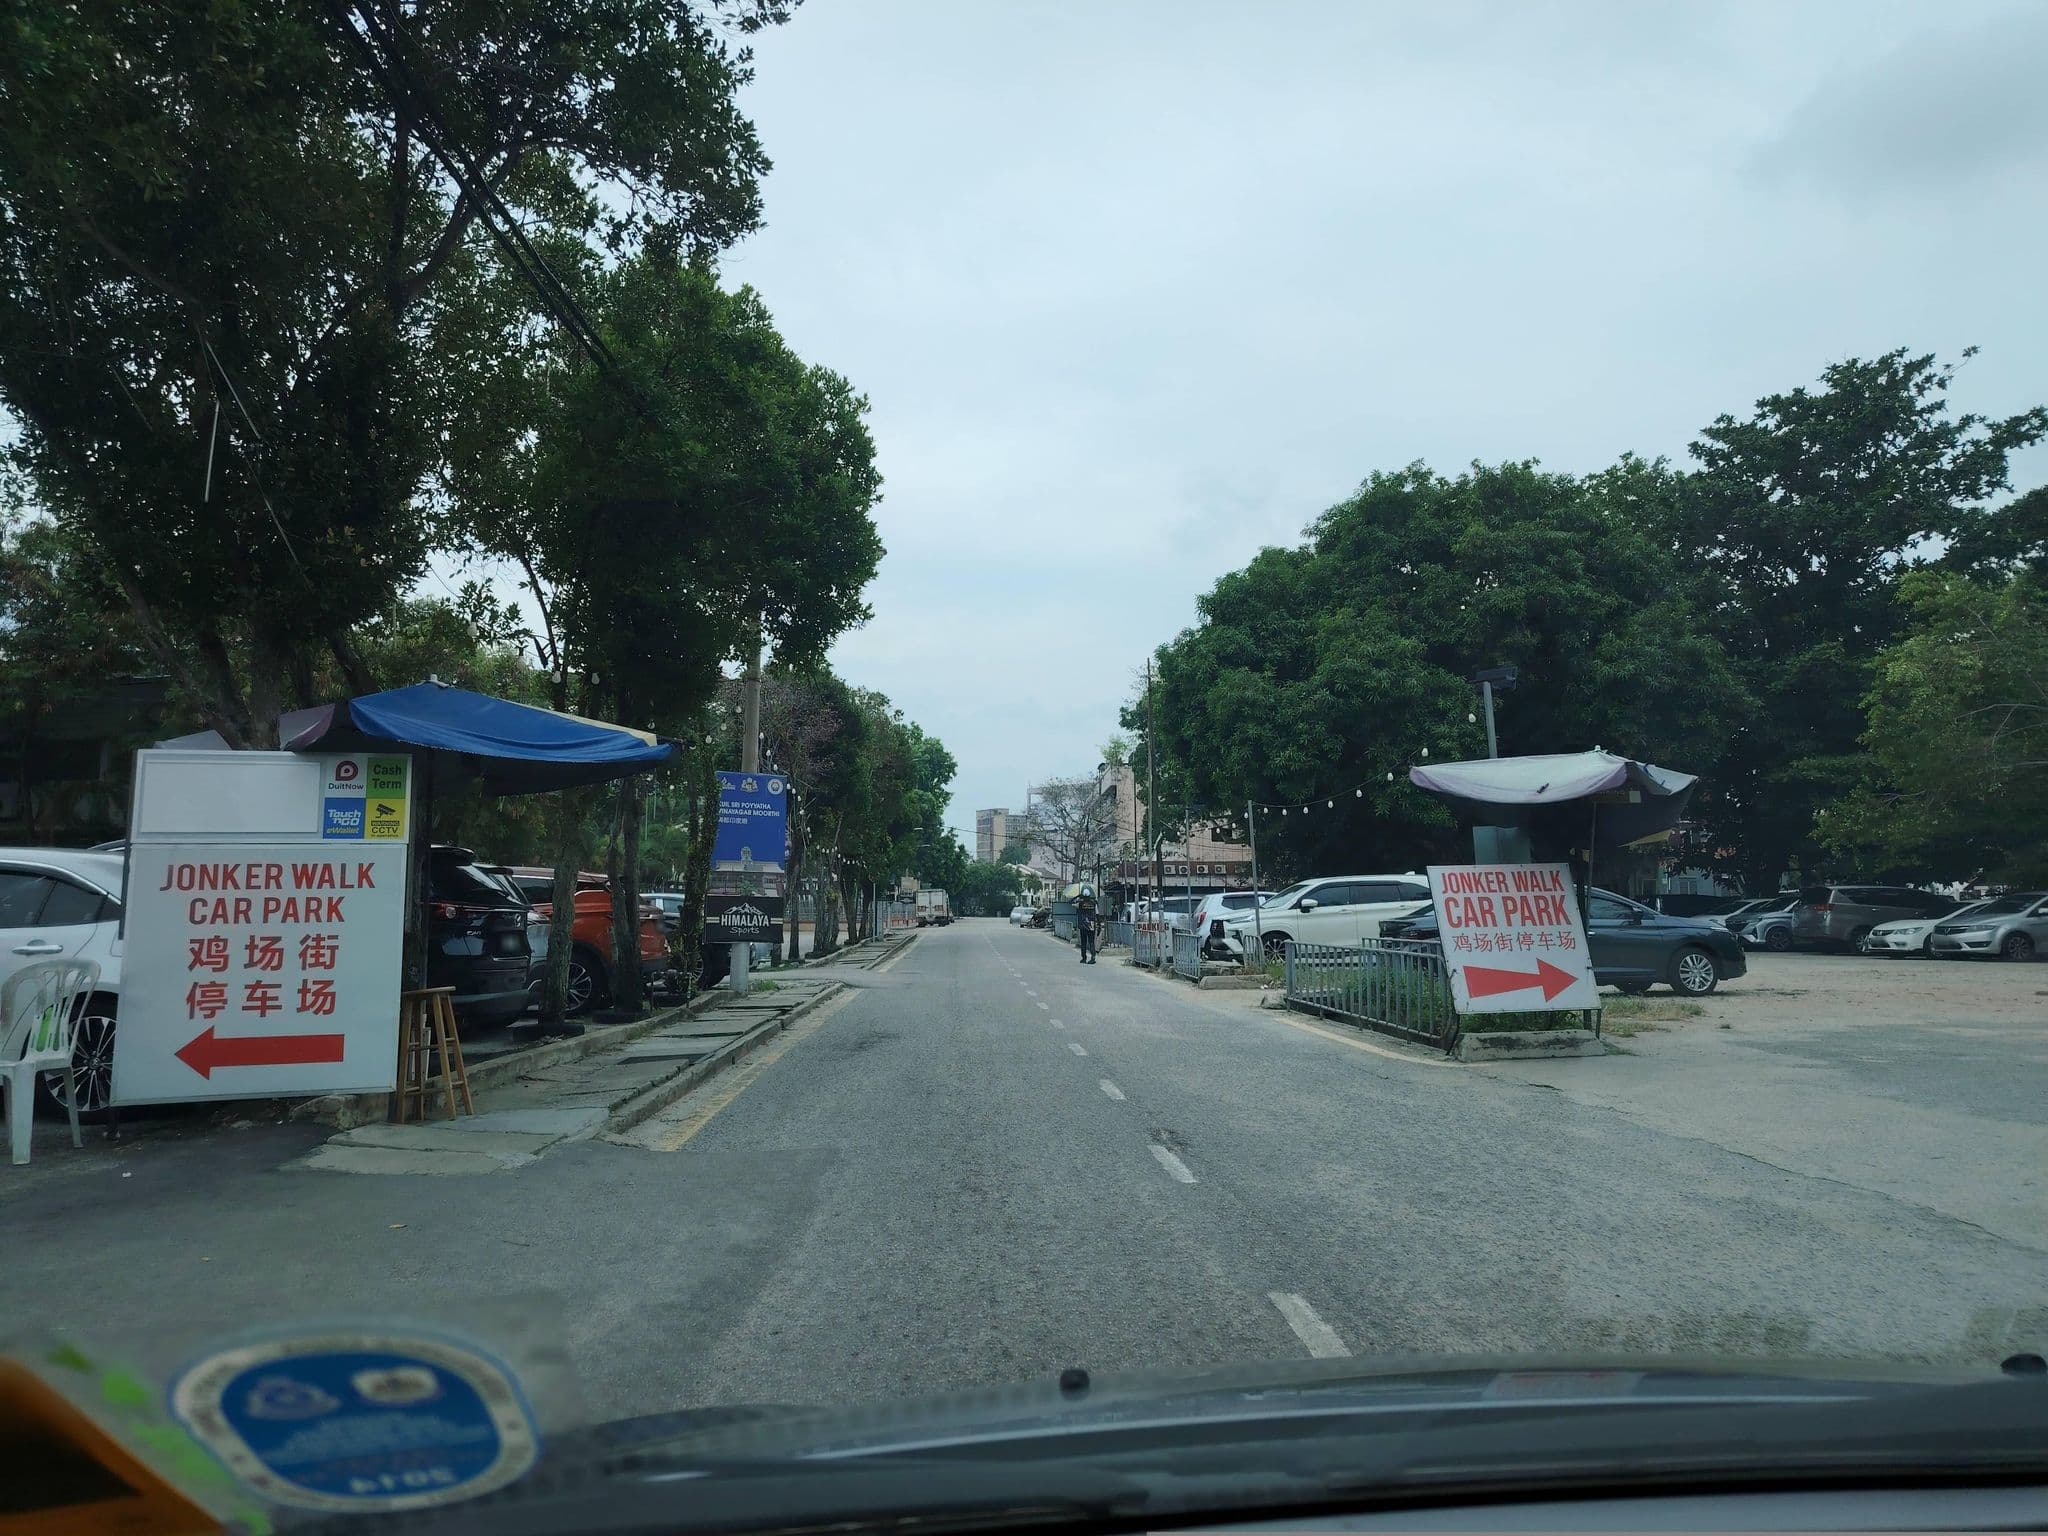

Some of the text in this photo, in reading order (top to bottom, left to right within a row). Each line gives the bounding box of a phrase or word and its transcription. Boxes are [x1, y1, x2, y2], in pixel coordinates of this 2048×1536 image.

[373, 764, 402, 776] Cash
[328, 782, 364, 790] DuitNow
[372, 778, 402, 790] Term
[328, 809, 361, 818] Touch
[160, 862, 376, 891] JONKER WALK
[1442, 870, 1565, 894] JONKER WALK
[189, 896, 345, 925] CAR PARK
[721, 914, 769, 927] HIMALAYA
[1444, 895, 1572, 928] CAR PARK
[730, 927, 760, 936] Sports
[1453, 931, 1576, 952] 鸡场街停车场
[187, 934, 339, 973] 鸡场街
[185, 979, 337, 1020] 停车场
